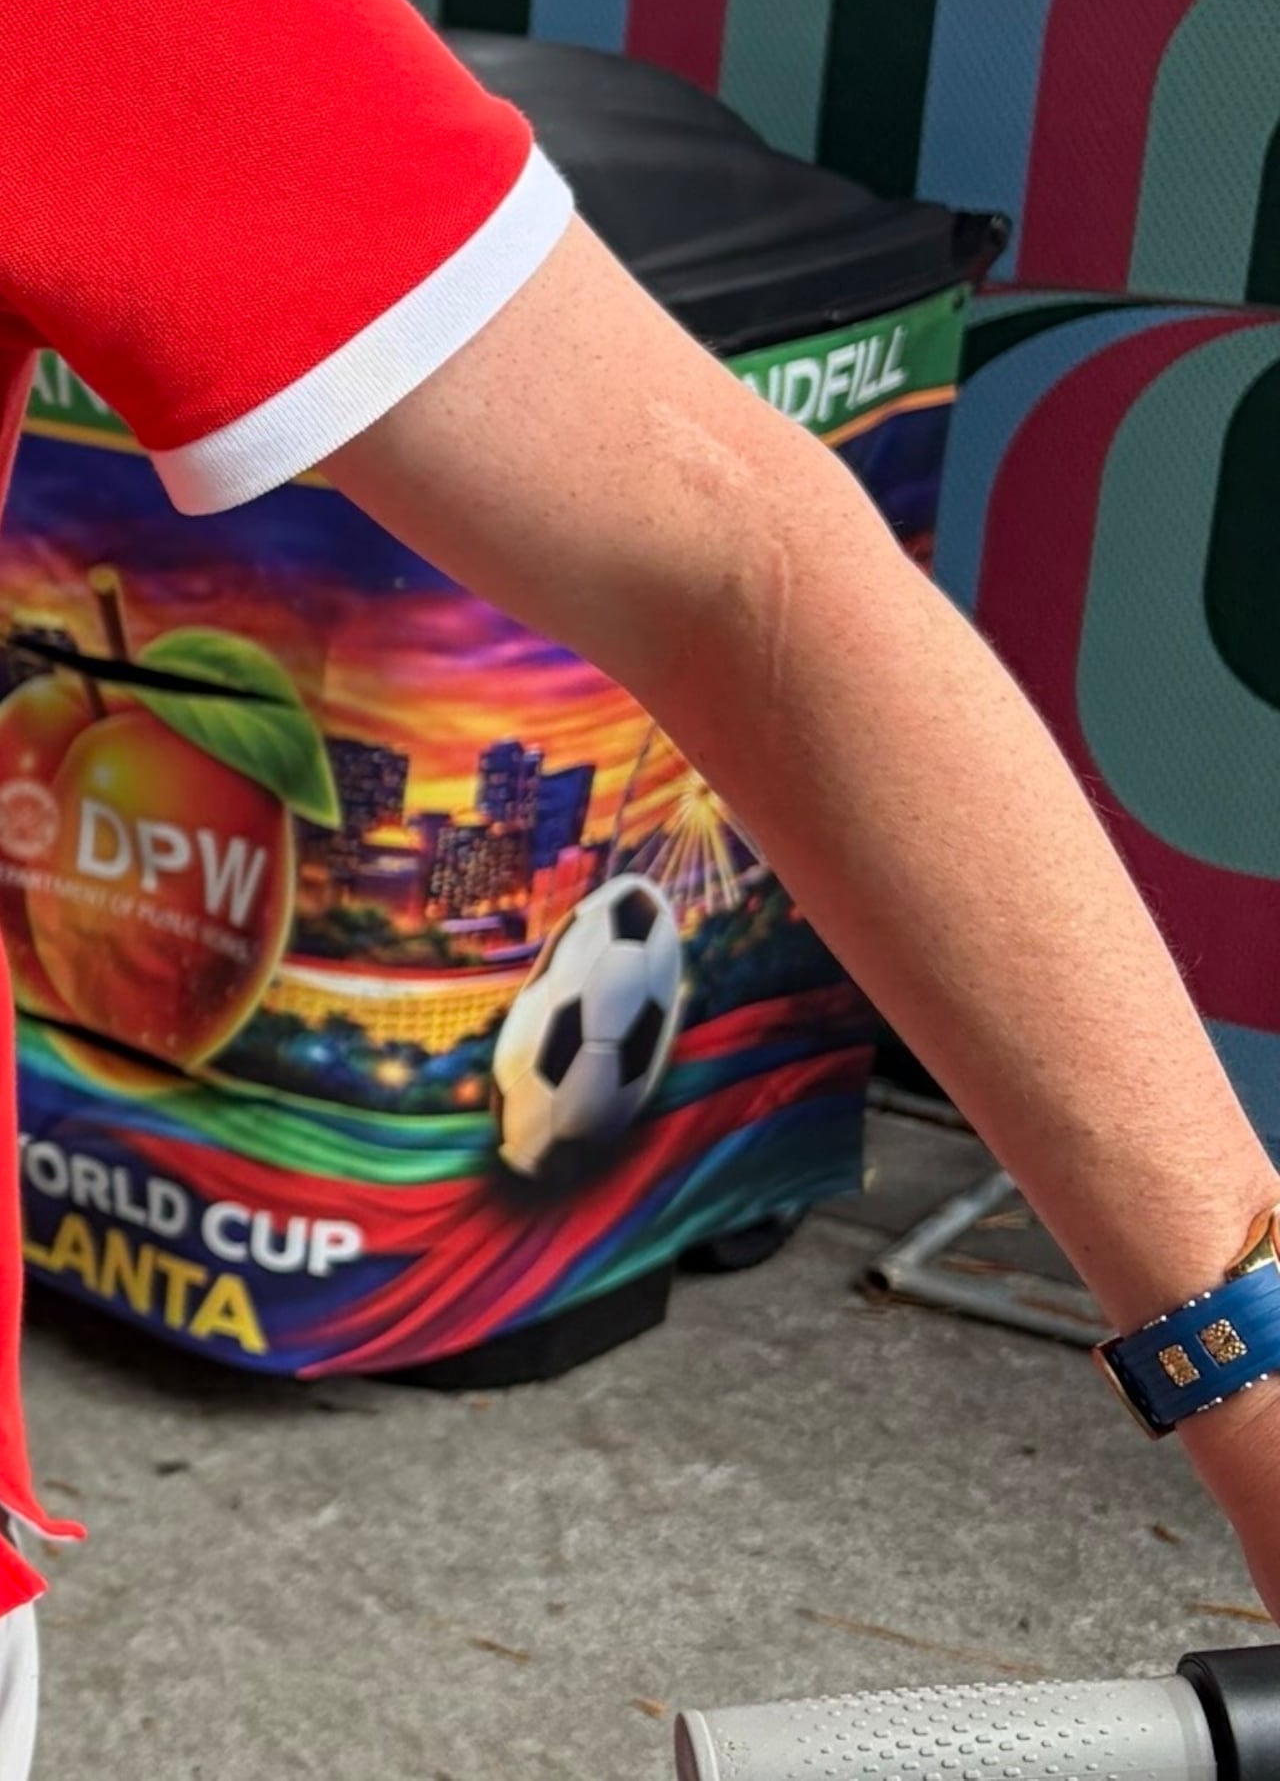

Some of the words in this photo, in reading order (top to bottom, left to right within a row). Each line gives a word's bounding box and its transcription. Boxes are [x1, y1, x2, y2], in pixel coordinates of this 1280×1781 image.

[76, 795, 267, 928] DPW
[19, 1133, 188, 1239] ORLD
[201, 1200, 364, 1277] CUP
